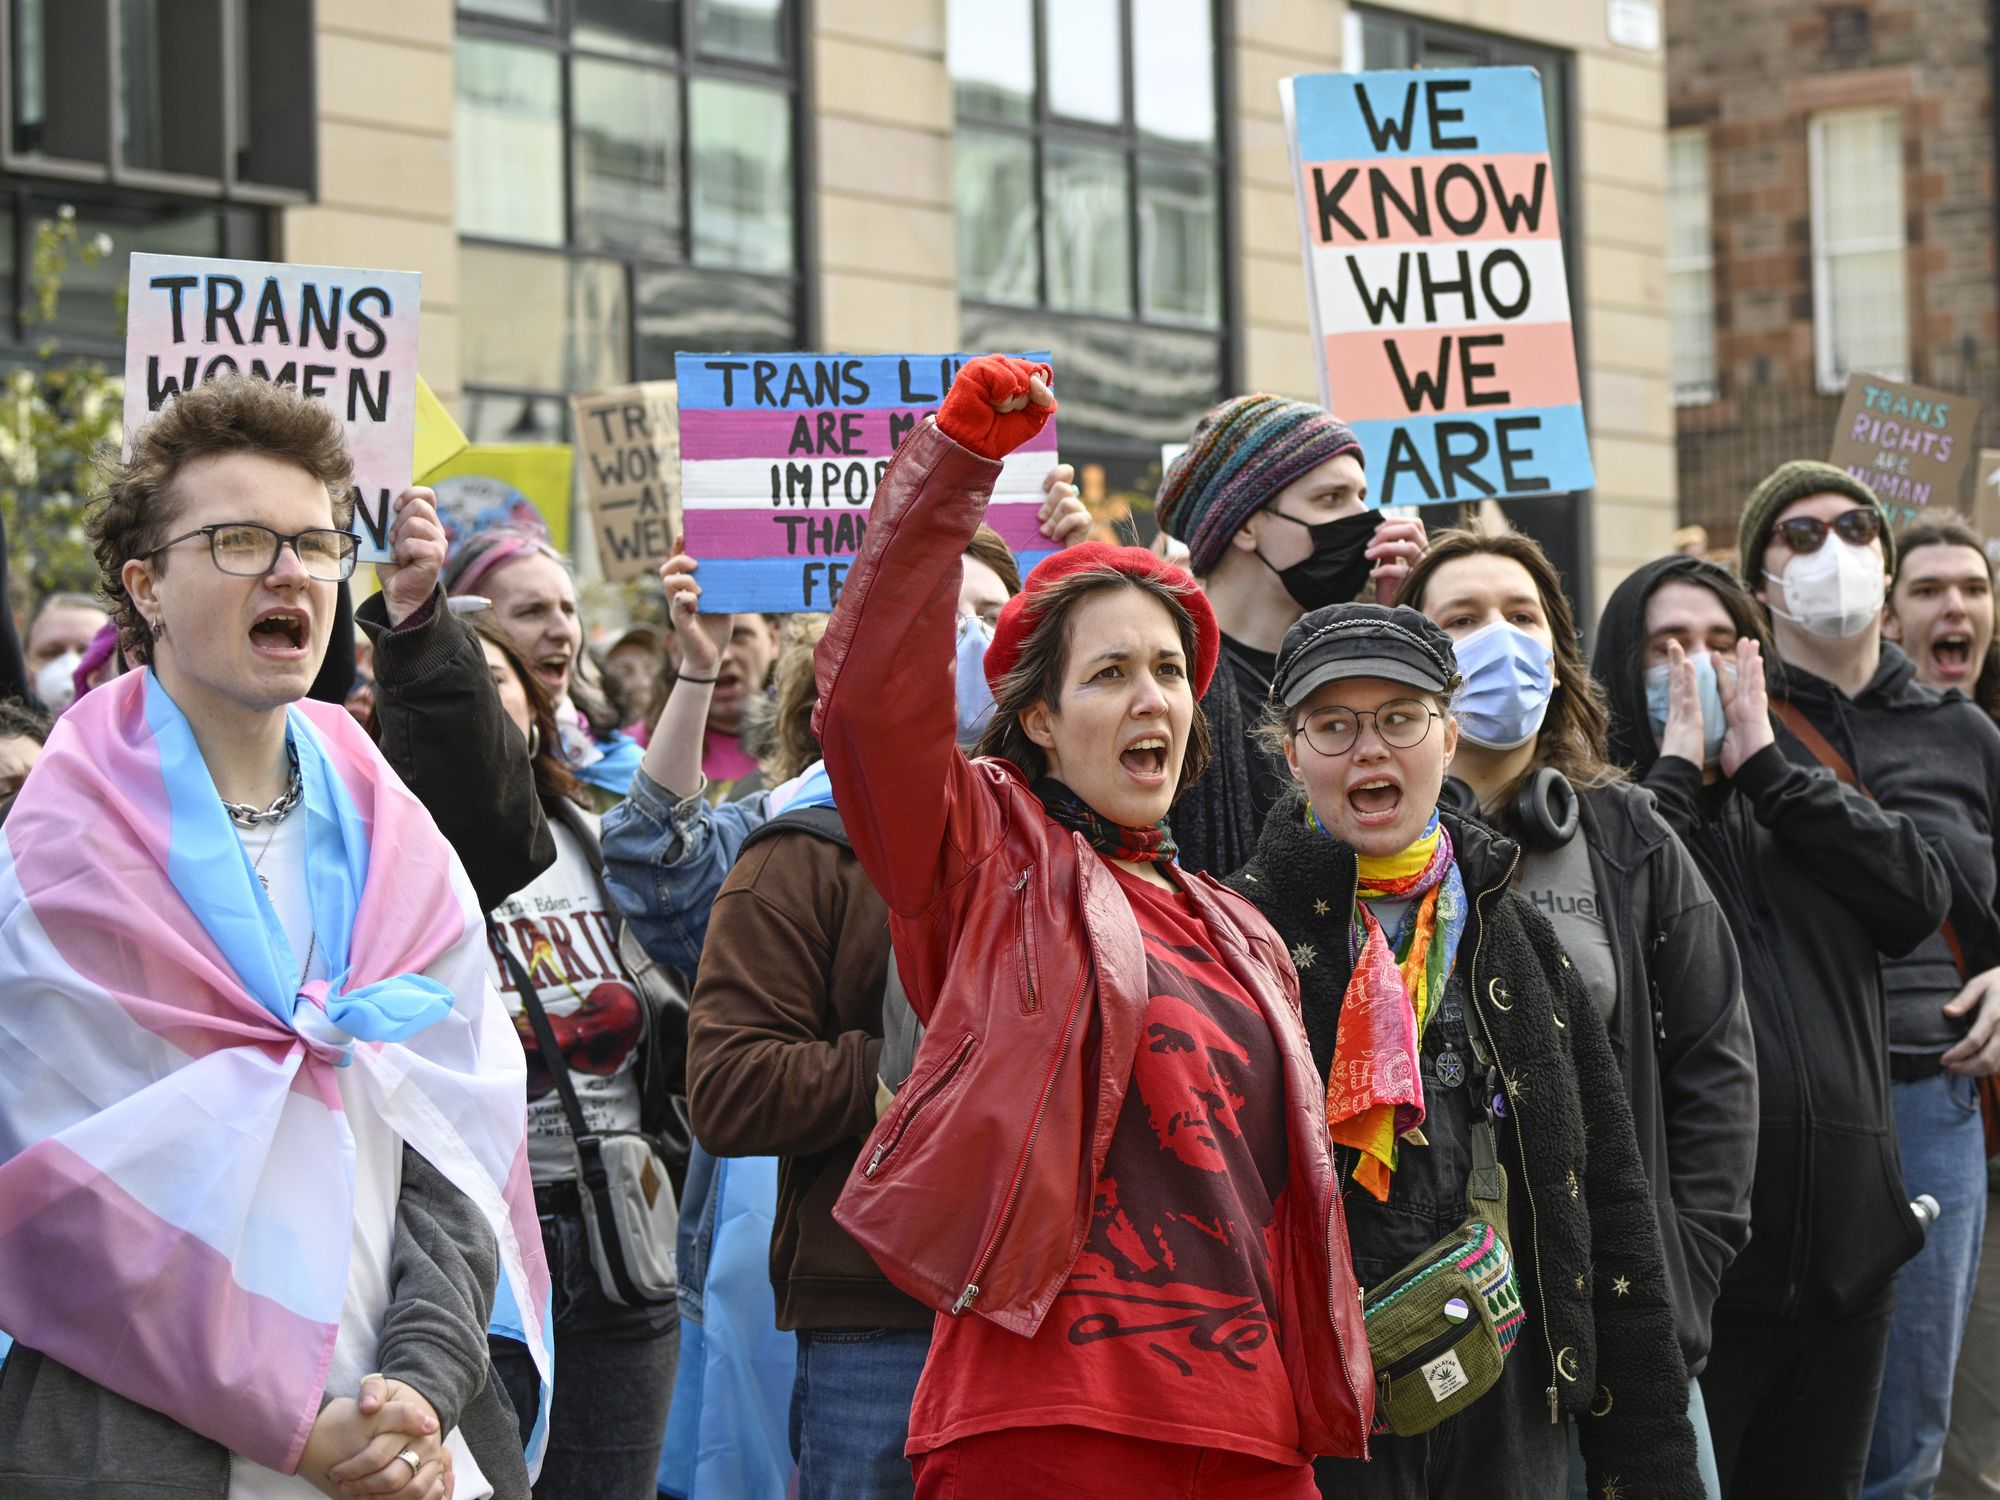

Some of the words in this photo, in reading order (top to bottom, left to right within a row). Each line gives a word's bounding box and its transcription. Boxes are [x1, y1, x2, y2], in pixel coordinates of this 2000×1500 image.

[1354, 80, 1478, 152] WE
[1313, 163, 1547, 242] KNOW
[150, 275, 392, 359] TRANS
[1346, 248, 1531, 325] WHO
[704, 360, 870, 408] TRANS
[1383, 334, 1510, 412] WE
[1864, 385, 1949, 429] TRANS
[788, 412, 868, 456] ARE
[890, 411, 937, 452] M
[1381, 417, 1550, 504] ARE
[1851, 413, 1954, 463] RIGHTS
[1873, 451, 1911, 475] ARE
